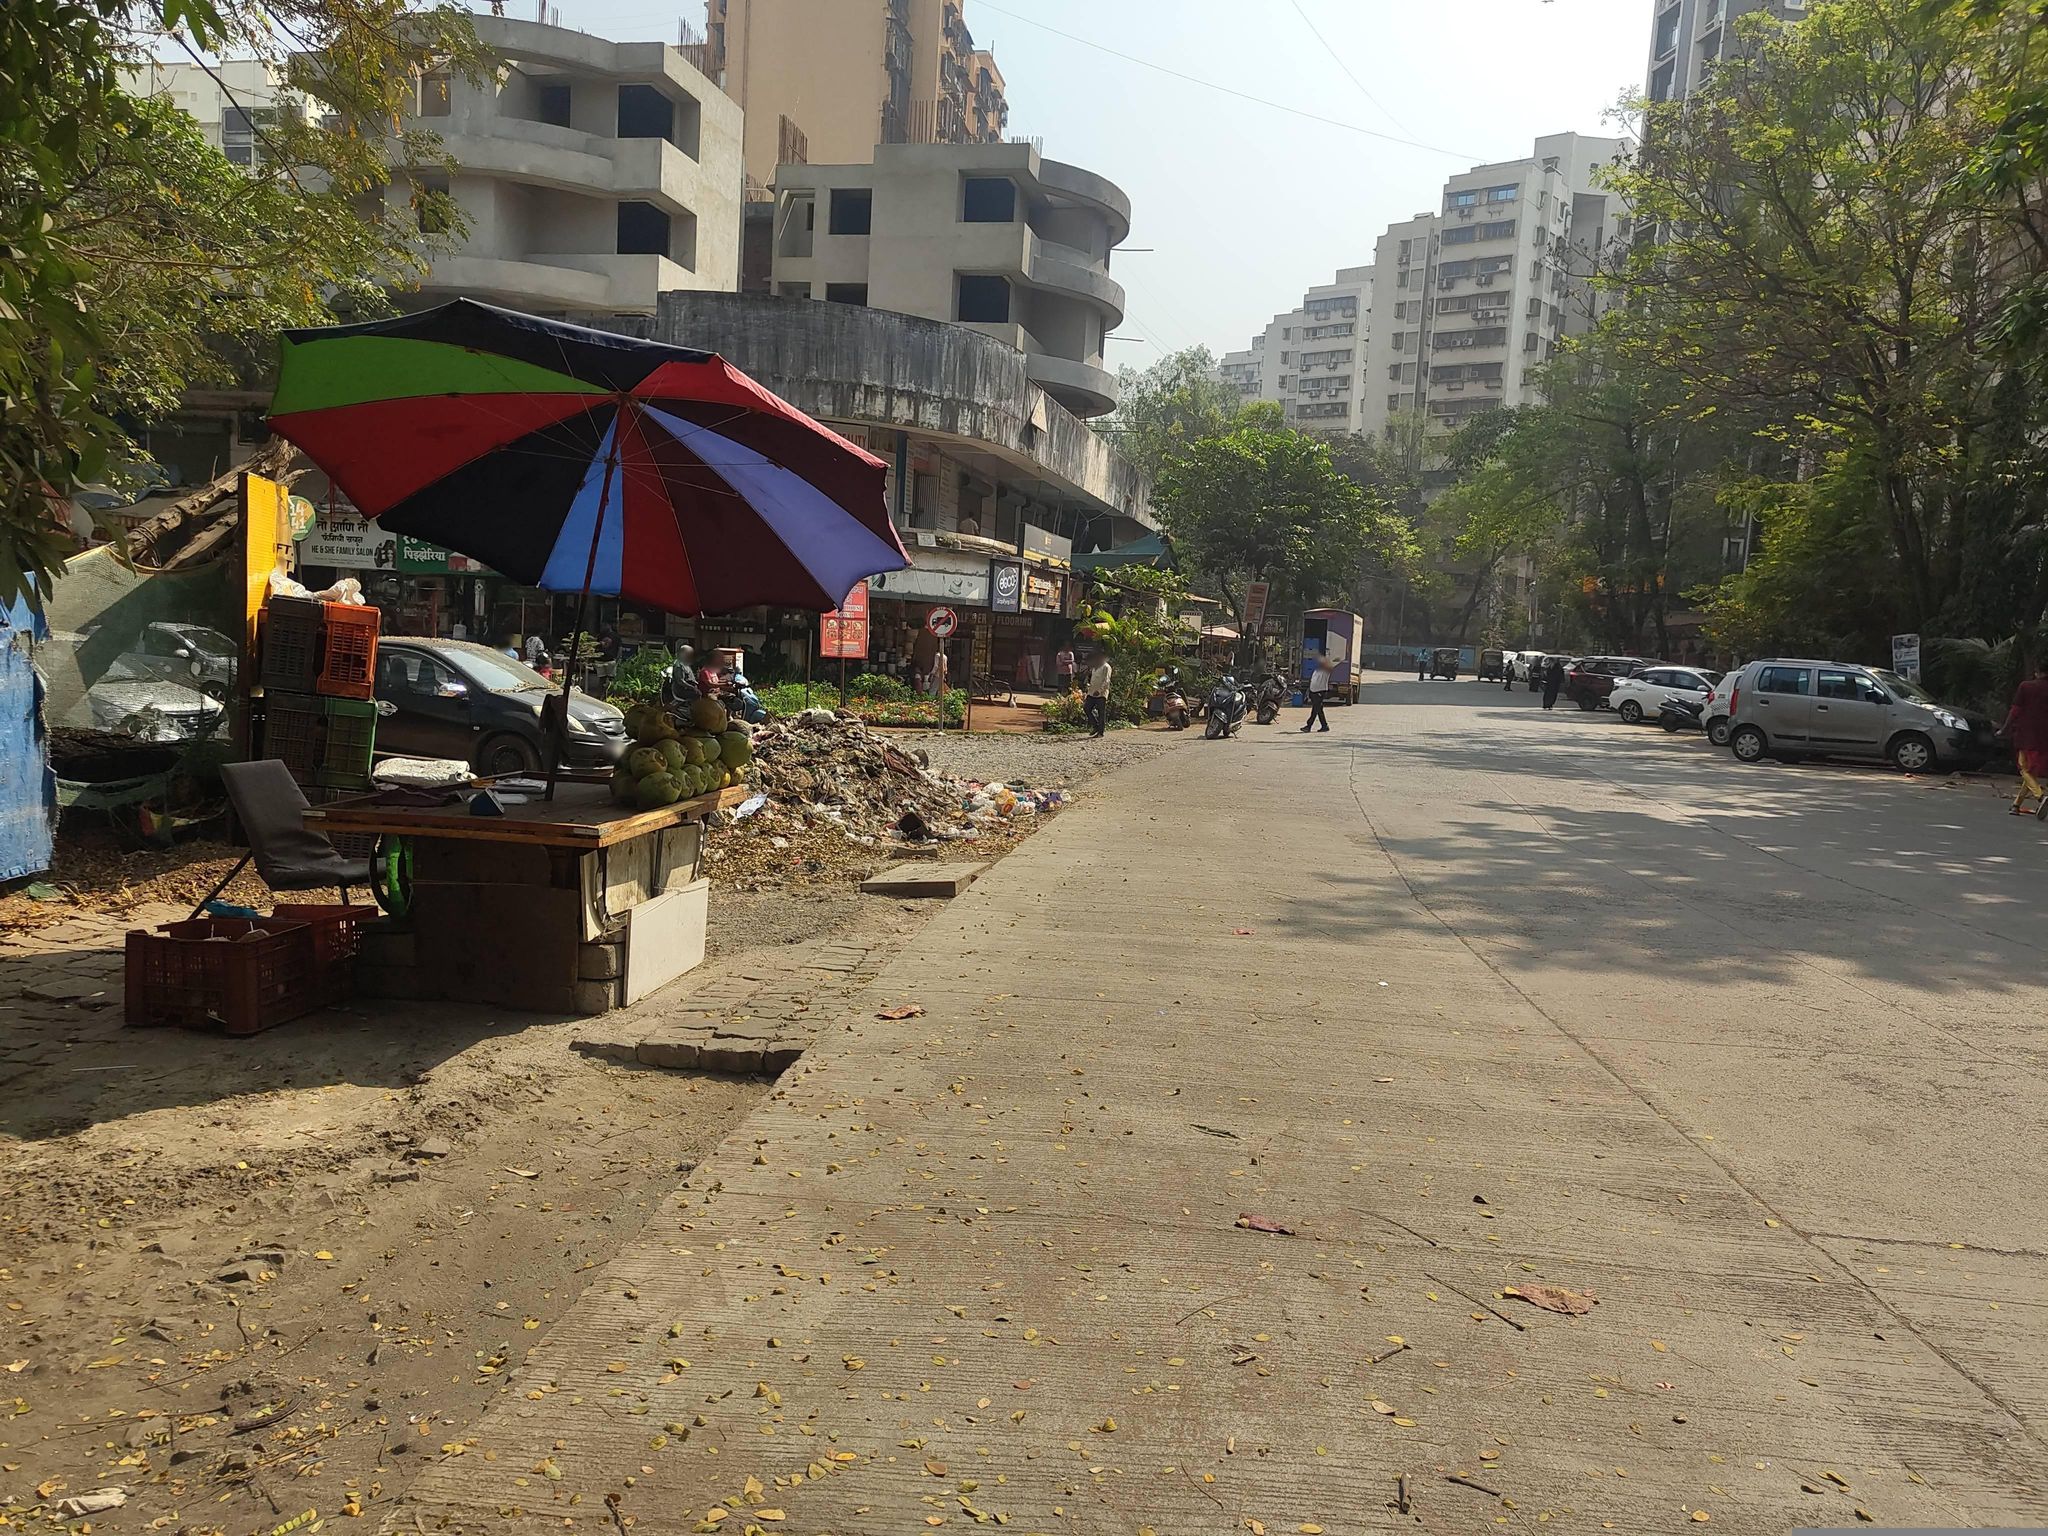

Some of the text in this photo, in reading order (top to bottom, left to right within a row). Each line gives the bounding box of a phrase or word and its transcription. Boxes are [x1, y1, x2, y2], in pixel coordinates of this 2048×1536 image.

[357, 520, 369, 534] ती
[311, 545, 319, 554] HE
[324, 545, 335, 554] SHE
[336, 546, 355, 555] FAMILY
[355, 547, 374, 557] SALON
[996, 615, 1032, 627] FLOORING
